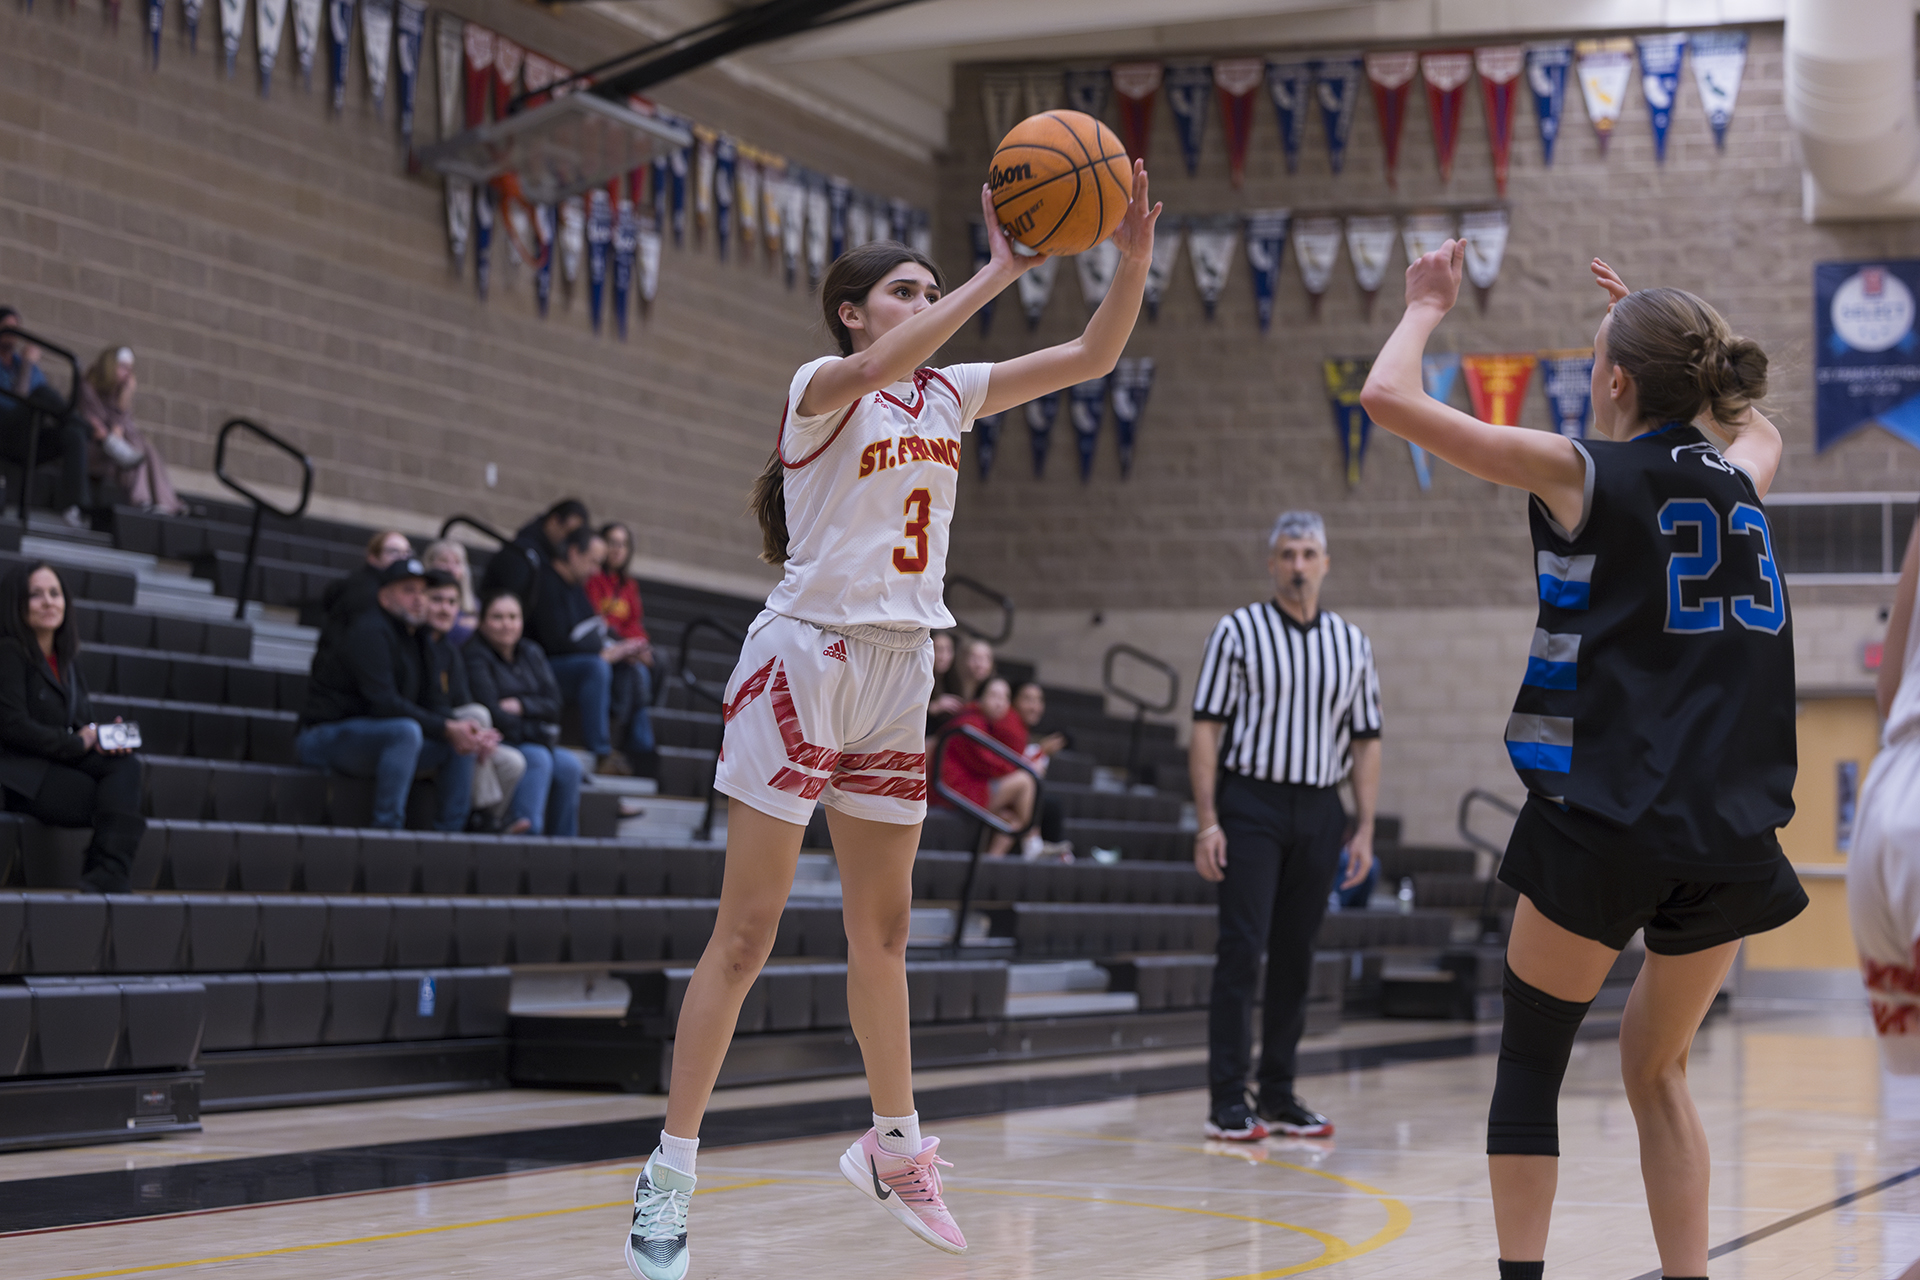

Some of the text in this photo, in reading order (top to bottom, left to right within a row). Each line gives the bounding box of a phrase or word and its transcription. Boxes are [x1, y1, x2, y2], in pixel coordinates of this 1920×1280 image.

[989, 162, 1031, 191] lson
[892, 487, 931, 574] 3
[1657, 498, 1786, 636] 23
